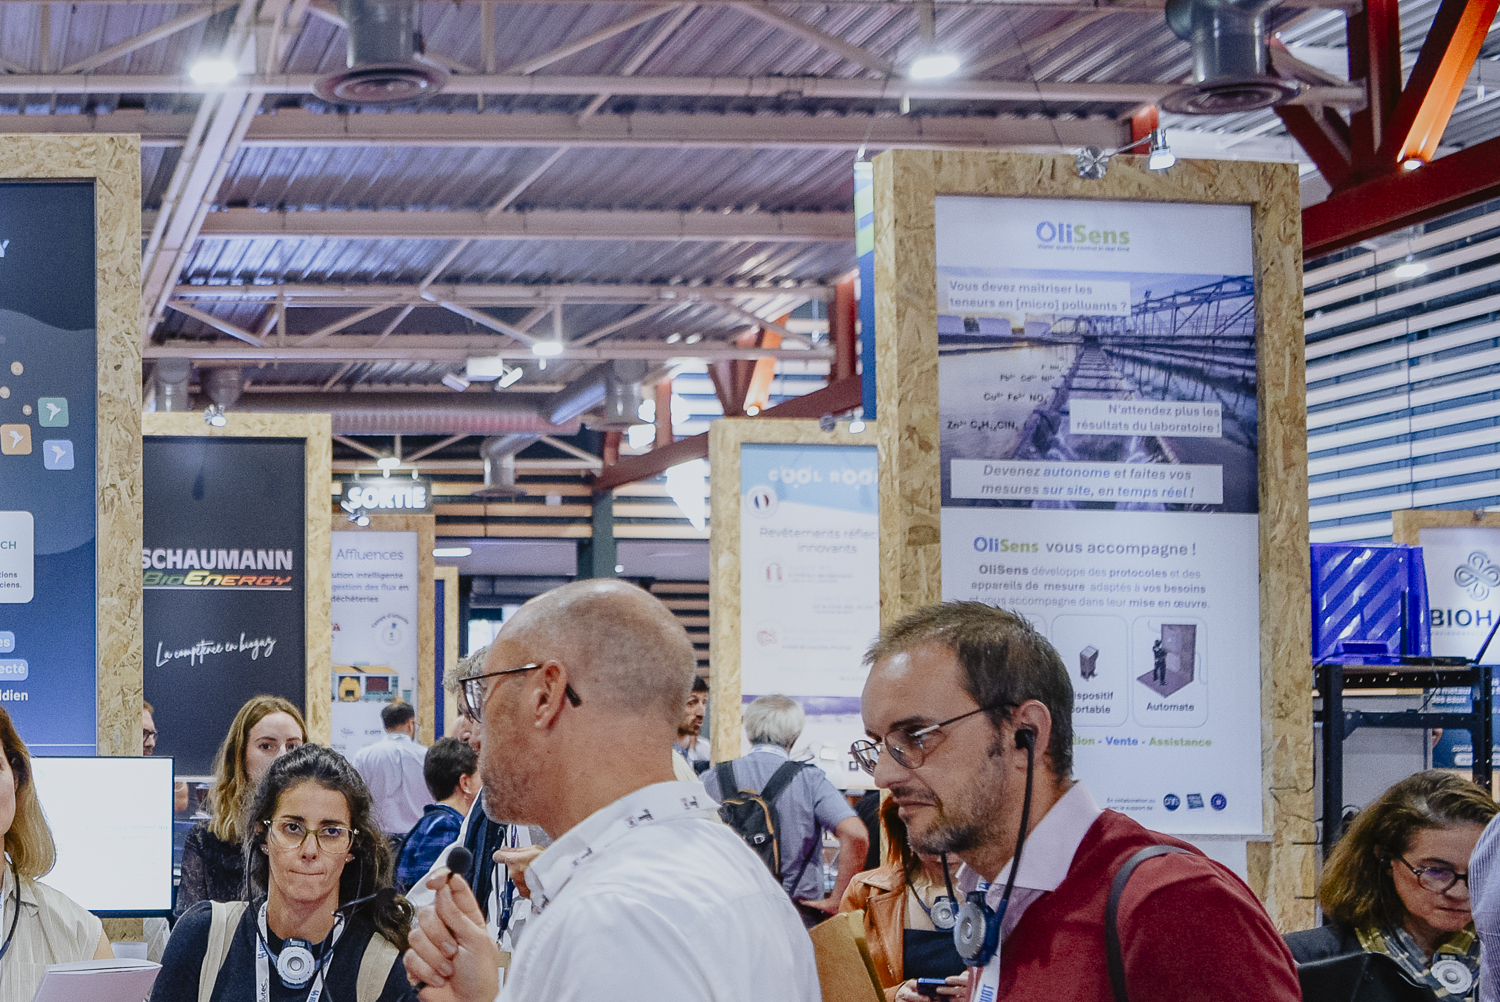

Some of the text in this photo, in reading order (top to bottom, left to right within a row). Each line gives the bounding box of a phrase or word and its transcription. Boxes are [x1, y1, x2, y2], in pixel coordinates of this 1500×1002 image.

[1036, 221, 1130, 245] OliSens
[950, 282, 979, 292] Vous
[983, 282, 1015, 292] devez
[1075, 284, 1092, 295] les
[949, 298, 1118, 311] teneurs en [micro] polluants
[1109, 404, 1220, 417] N'attendez plus les
[1076, 420, 1214, 433] résultats du laboratoire
[830, 468, 878, 485] ROO
[984, 465, 1191, 481] Devenez autonome et faites vos
[981, 484, 1187, 499] mesures sur site, en temps réel
[348, 487, 426, 510] SORTIE
[761, 528, 841, 538] Revêtements
[798, 544, 857, 553] innovants
[973, 537, 1189, 557] OliSens vous accompagne
[143, 549, 292, 570] SCHAUMANN
[336, 549, 404, 561] Affluences
[356, 571, 403, 582] intelligente
[979, 564, 1200, 580] OliSens développe des protocoles et des
[332, 583, 362, 592] gestion
[365, 583, 378, 591] des
[972, 581, 1205, 595] appareils de mesure adaptés à vos besoins
[1009, 597, 1076, 608] accompagne
[1079, 597, 1104, 607] dans
[1106, 599, 1127, 607] leur
[1129, 599, 1155, 608] mise
[1158, 600, 1171, 608] en
[1431, 610, 1492, 627] BIOH
[156, 642, 173, 667] La
[1074, 691, 1113, 702] ispositif
[1146, 702, 1194, 712] Automate
[1105, 736, 1212, 747] Vente Assistance
